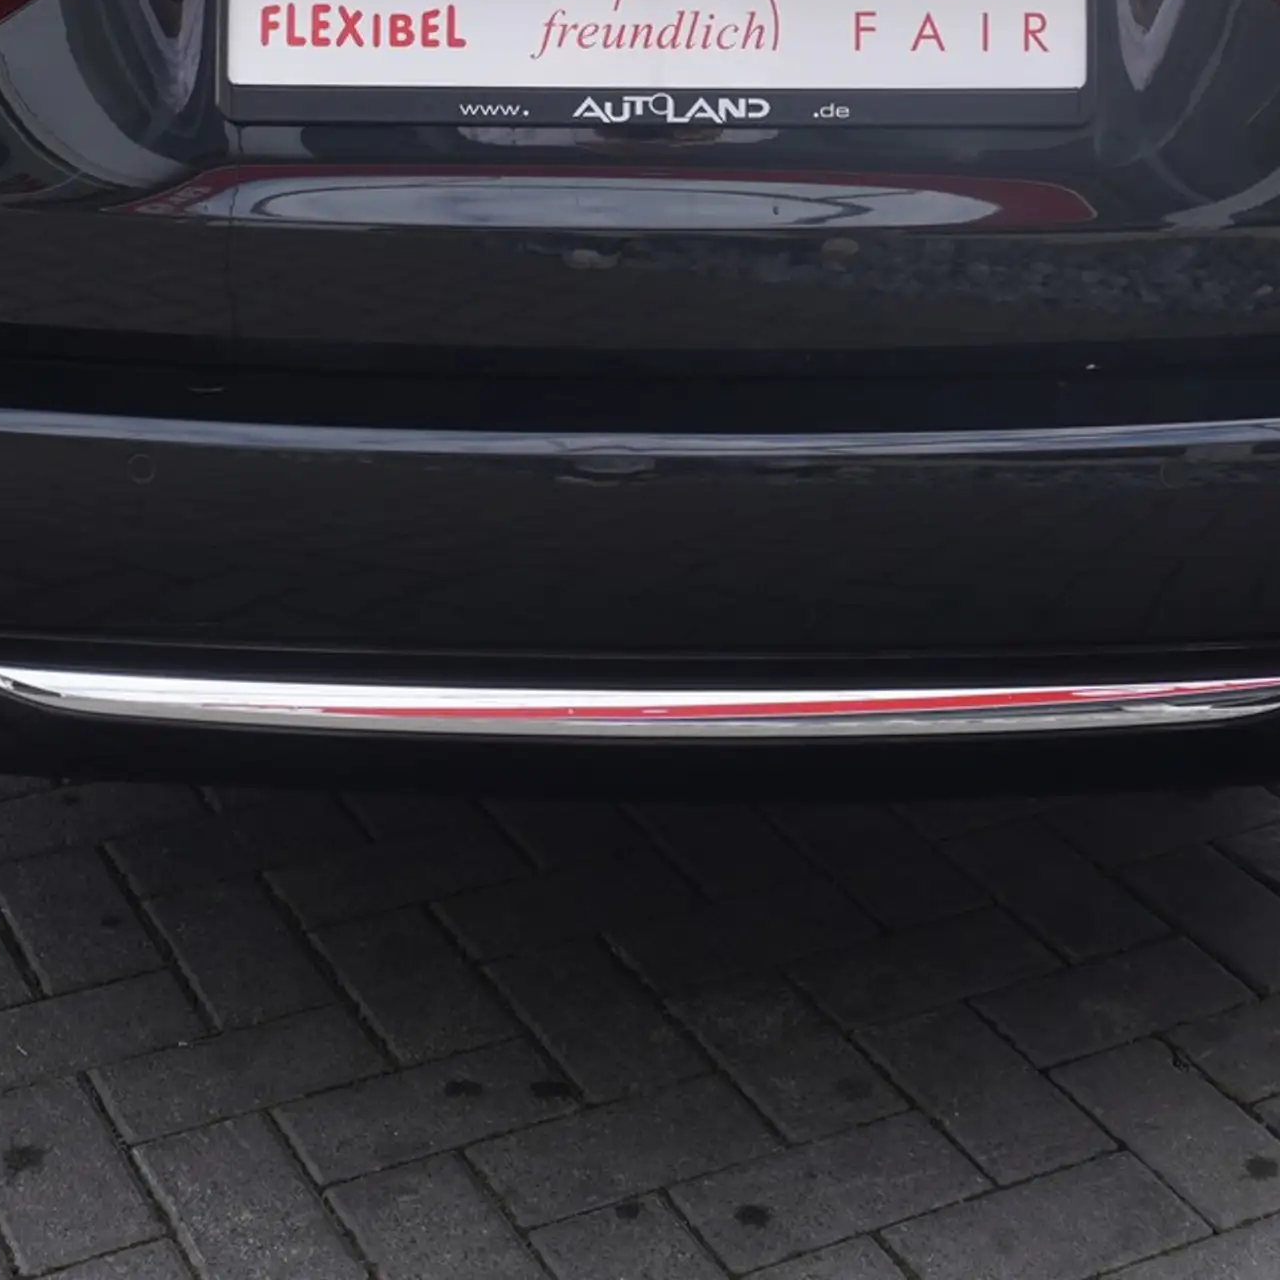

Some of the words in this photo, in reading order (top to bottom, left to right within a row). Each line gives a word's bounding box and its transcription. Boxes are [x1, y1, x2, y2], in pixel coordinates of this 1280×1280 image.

[260, 2, 467, 48] FLEXIBEL
[530, 8, 766, 60] freundlich
[853, 10, 1050, 53] FAIR
[459, 103, 530, 117] www.
[573, 93, 771, 123] AUTOLAND
